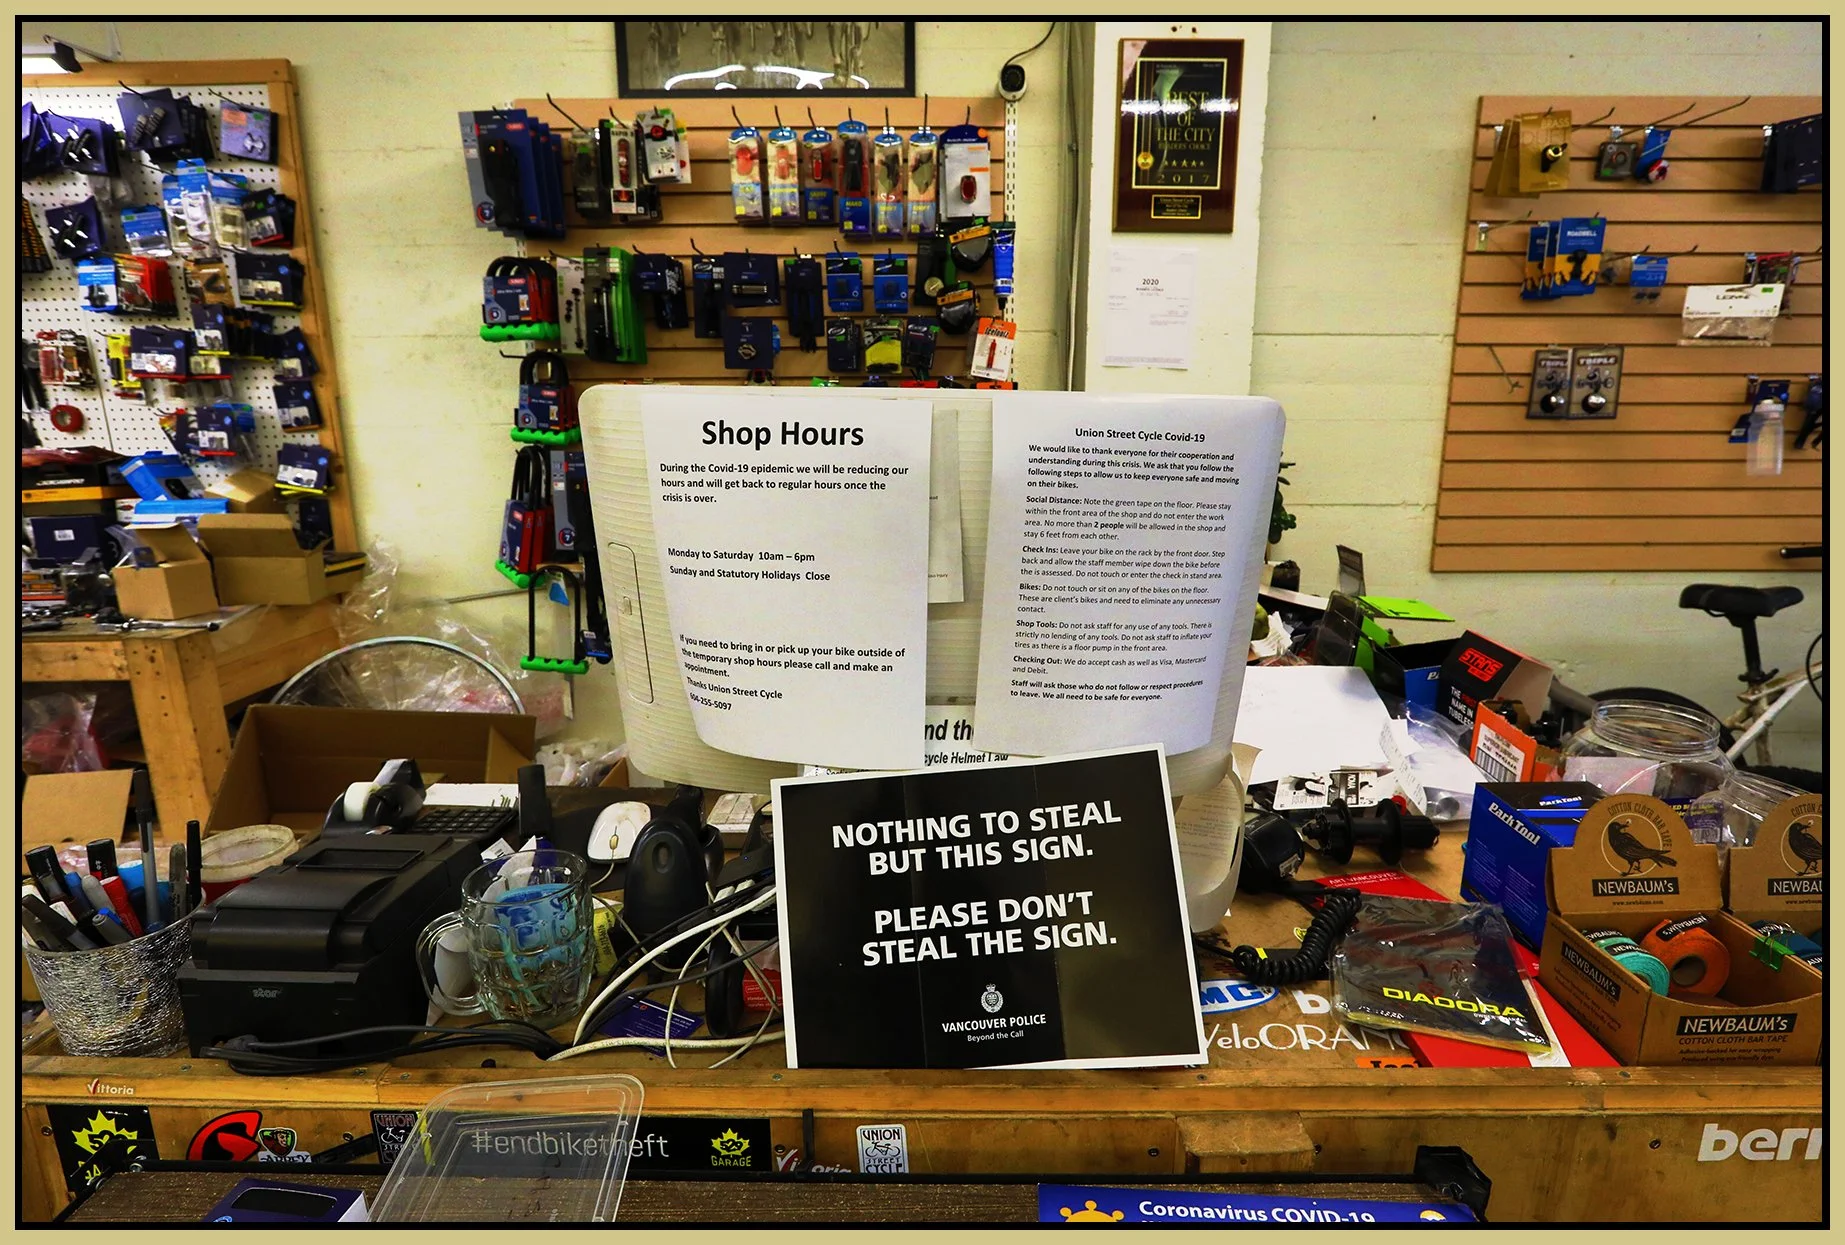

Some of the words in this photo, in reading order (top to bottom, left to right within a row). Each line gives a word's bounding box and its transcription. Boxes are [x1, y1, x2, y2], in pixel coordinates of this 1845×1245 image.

[1177, 112, 1195, 126] OF
[1540, 118, 1570, 129] BRASS
[1157, 128, 1180, 142] THE
[1185, 128, 1215, 142] CITY
[1579, 357, 1616, 365] TRIPLE
[701, 419, 772, 451] Shop
[781, 420, 864, 447] Hours
[1076, 428, 1104, 437] Union
[1107, 430, 1135, 439] Street
[1138, 431, 1162, 441] Cycle
[1165, 432, 1205, 442] Covid-19
[660, 464, 688, 474] During
[691, 464, 706, 472] the
[708, 464, 748, 472] Covid-19
[751, 464, 794, 474] epidemic
[813, 465, 830, 473] will
[833, 465, 844, 473] be
[848, 465, 889, 476] reducing
[661, 478, 685, 487] hours
[688, 479, 703, 487] and
[706, 479, 722, 487] will
[725, 480, 739, 489] get
[742, 480, 763, 488] back
[779, 480, 812, 490] regular
[815, 480, 841, 489] hours
[870, 481, 885, 490] the
[663, 493, 682, 502] crisis
[685, 494, 691, 502] is
[668, 548, 700, 559] Monday
[714, 551, 753, 561] Saturday
[759, 552, 783, 560] 10am
[794, 553, 814, 562] 6pm
[670, 566, 697, 577] Sunday
[717, 569, 759, 580] Statutory
[762, 571, 800, 581] Holidays
[806, 572, 830, 580] Close
[680, 634, 685, 642] If
[685, 637, 698, 646] you
[698, 640, 717, 648] need
[731, 642, 753, 653] bring
[755, 643, 763, 652] in
[777, 645, 796, 655] pick
[798, 648, 809, 656] up
[811, 648, 832, 656] your
[835, 647, 855, 656] bike
[857, 648, 892, 657] outside
[894, 648, 905, 657] of
[681, 648, 692, 657] the
[692, 651, 732, 665] temporary
[734, 656, 754, 667] shop
[756, 658, 782, 667] hours
[784, 660, 812, 670] please
[815, 661, 830, 670] call
[832, 662, 850, 671] and
[852, 663, 878, 671] make
[684, 662, 730, 677] appointment.
[687, 677, 707, 690] Thanks
[708, 684, 731, 694] Union
[732, 687, 758, 697] Street
[760, 690, 783, 699] Cycle
[1451, 686, 1462, 699] THE
[1451, 698, 1467, 714] NAME
[1467, 707, 1474, 718] IN
[925, 719, 948, 740] nd
[953, 719, 973, 740] th
[925, 752, 948, 767] ycle
[951, 751, 985, 764] Helmet
[1539, 796, 1582, 807] ParkTool
[1791, 801, 1816, 817] COTTON
[832, 815, 971, 849] NOTHING
[980, 811, 1019, 835] TO
[1030, 800, 1121, 831] STEAL
[1487, 802, 1542, 846] ParkTool
[1607, 802, 1632, 815] COTTON
[1634, 802, 1655, 819] CLOTH
[1652, 815, 1666, 830] BAR
[1661, 829, 1673, 848] TAPE
[869, 848, 926, 876] BUT
[936, 842, 1002, 869] THIS
[1012, 834, 1093, 863] SIGN.
[1597, 880, 1674, 895] NEWBAUM's
[874, 901, 988, 934] PLEASE
[999, 891, 1093, 922] DON'T
[1585, 929, 1624, 941] EWBAUM's
[862, 937, 957, 967] STEAL
[966, 928, 1024, 957] THE
[1034, 920, 1117, 951] SIGN.
[1563, 946, 1617, 996] NEWBAUM's
[1202, 984, 1264, 1006] MC
[1382, 987, 1525, 1018] DIADORA
[942, 1017, 1008, 1033] VANCOUVER
[1010, 1014, 1047, 1028] POLICE
[1684, 1016, 1788, 1033] NEWBAUM's
[967, 1033, 995, 1043] Beyond
[1010, 1030, 1024, 1039] Call
[1679, 1037, 1714, 1045] COTTON
[1717, 1036, 1745, 1044] CLOTH
[87, 1078, 134, 1095] Vittoria
[376, 1114, 415, 1127] UNION
[862, 1129, 901, 1140] UNION
[471, 1128, 670, 1158] #endbiketheft
[720, 1140, 744, 1151] 529
[711, 1155, 752, 1167] GARAGE
[866, 1156, 901, 1164] STREET
[1139, 1201, 1268, 1222] Coronavirus
[1271, 1207, 1376, 1223] COVID-19
